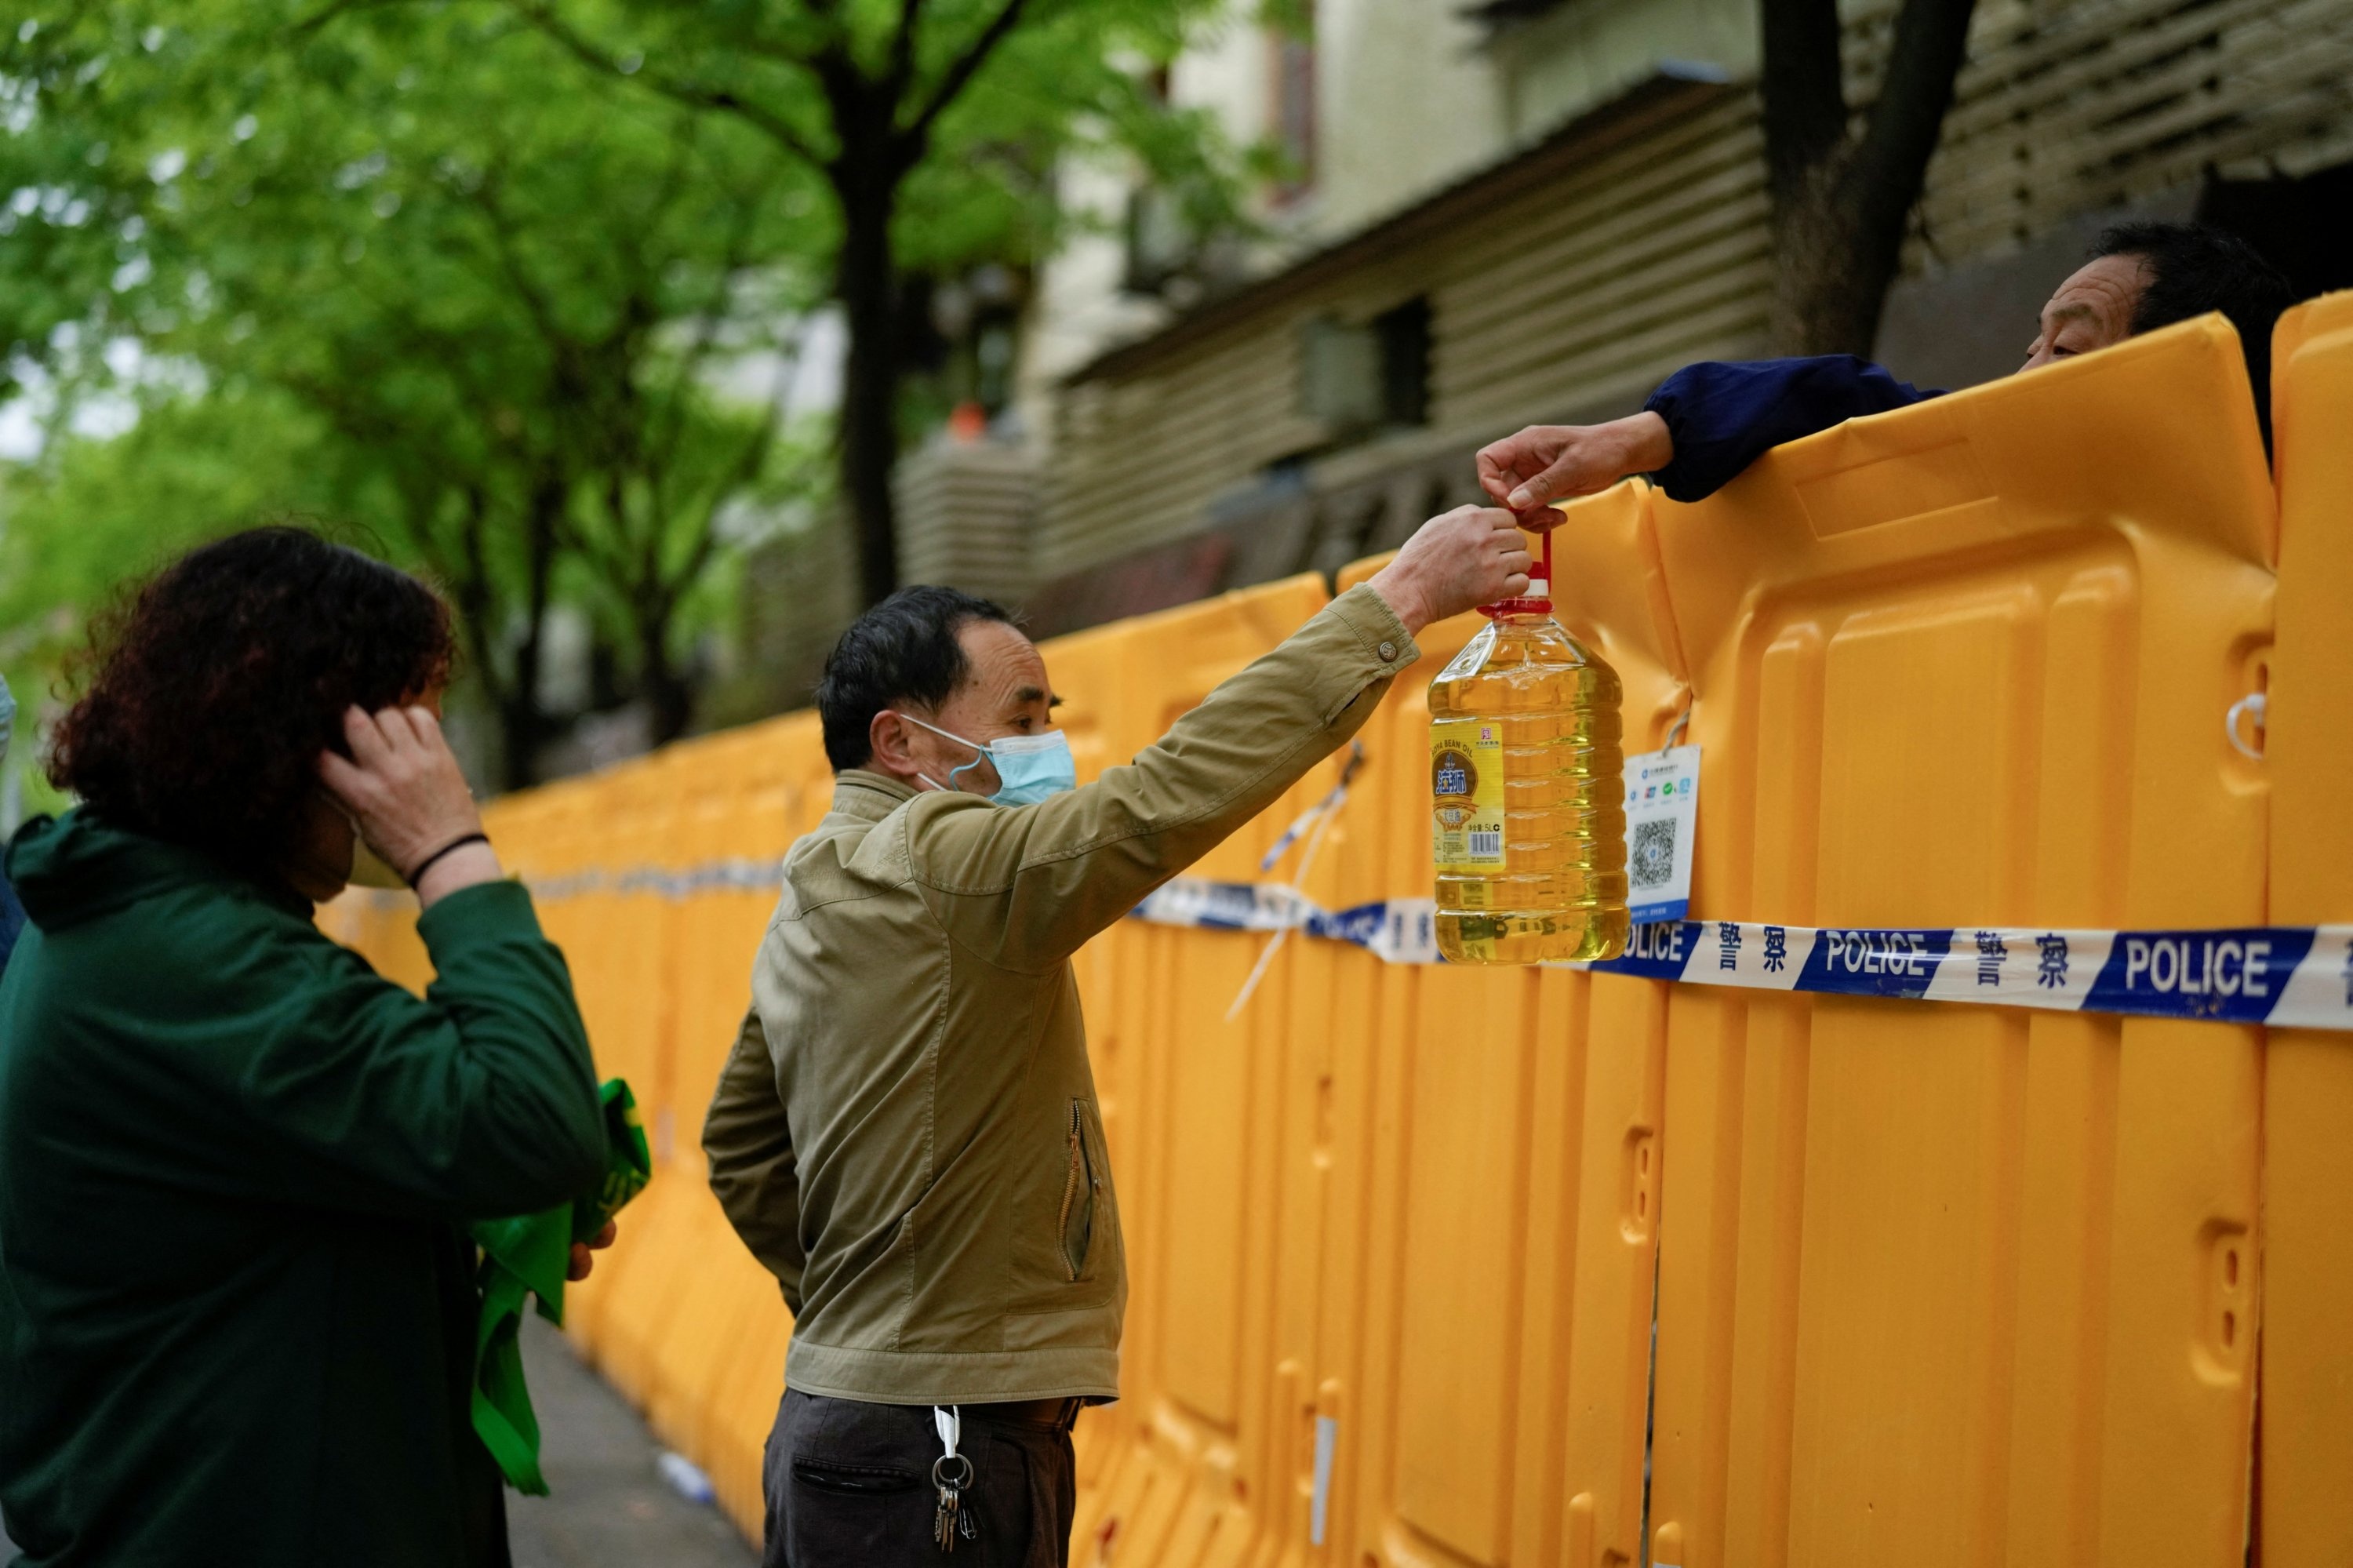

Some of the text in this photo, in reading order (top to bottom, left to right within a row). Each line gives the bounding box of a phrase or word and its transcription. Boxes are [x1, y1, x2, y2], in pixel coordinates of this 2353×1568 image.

[1444, 739, 1460, 749] BEAN
[1463, 744, 1473, 758] OIL
[1436, 769, 1467, 795] 海狮
[1443, 809, 1460, 821] 大豆油
[1624, 922, 2272, 997] OLICE 警察 POLICE 警察 POLICE
